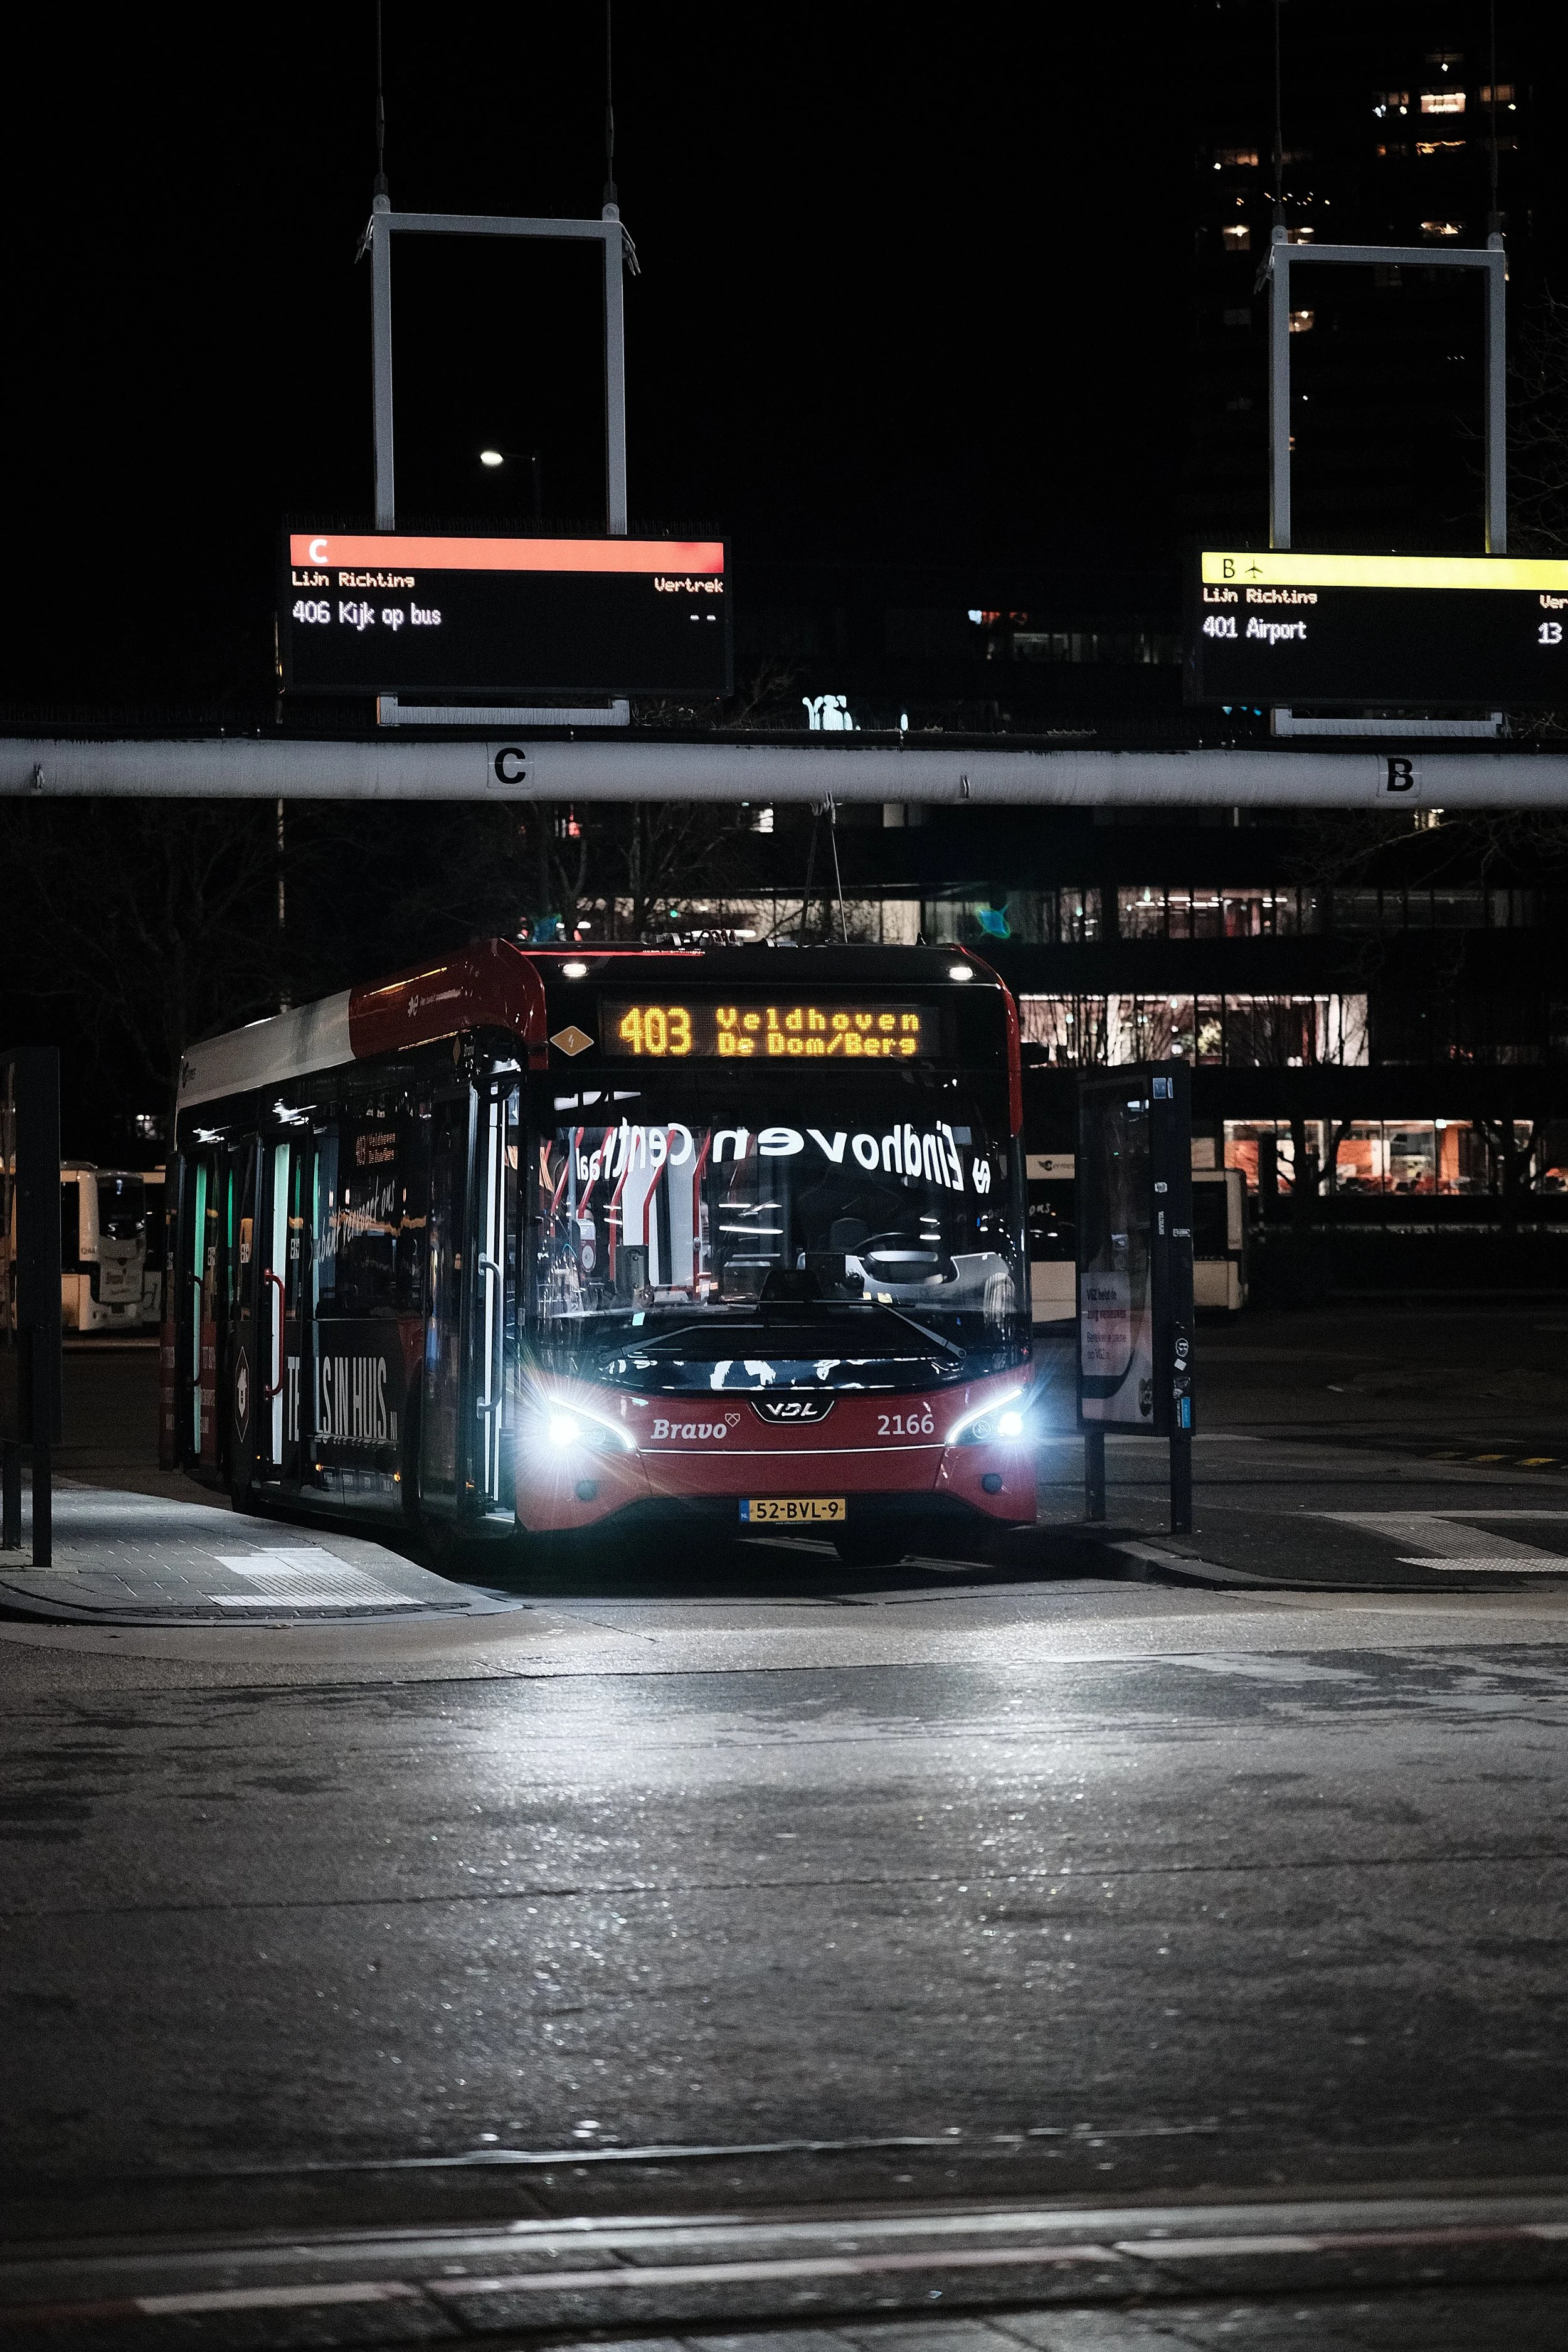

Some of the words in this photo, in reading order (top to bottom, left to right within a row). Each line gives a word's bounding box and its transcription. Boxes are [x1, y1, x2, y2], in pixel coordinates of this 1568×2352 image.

[308, 538, 329, 564] C
[292, 571, 330, 587] Lijn
[338, 571, 415, 588] Richting
[1223, 558, 1236, 579] B
[654, 576, 724, 593] Vertrek
[1203, 587, 1239, 603] Lijn
[1246, 588, 1318, 605] Richting
[292, 600, 331, 625] 406
[338, 601, 375, 632] Kijk
[381, 607, 405, 632] op
[410, 602, 442, 626] bus
[1202, 615, 1239, 638] 401
[1246, 617, 1307, 645] Airport
[1538, 621, 1563, 645] 13
[494, 747, 527, 785] C
[1386, 757, 1415, 792] B
[620, 1007, 692, 1055] 403
[716, 1007, 919, 1030] Veldhoven
[718, 1032, 756, 1055] De
[381, 1179, 395, 1217] ons
[334, 1356, 349, 1437] IN
[352, 1356, 388, 1440] HUIS
[765, 1402, 818, 1417] VDL
[650, 1419, 728, 1439] Bravo
[877, 1413, 935, 1435] 2166
[756, 1501, 839, 1519] 52-BVL-9
